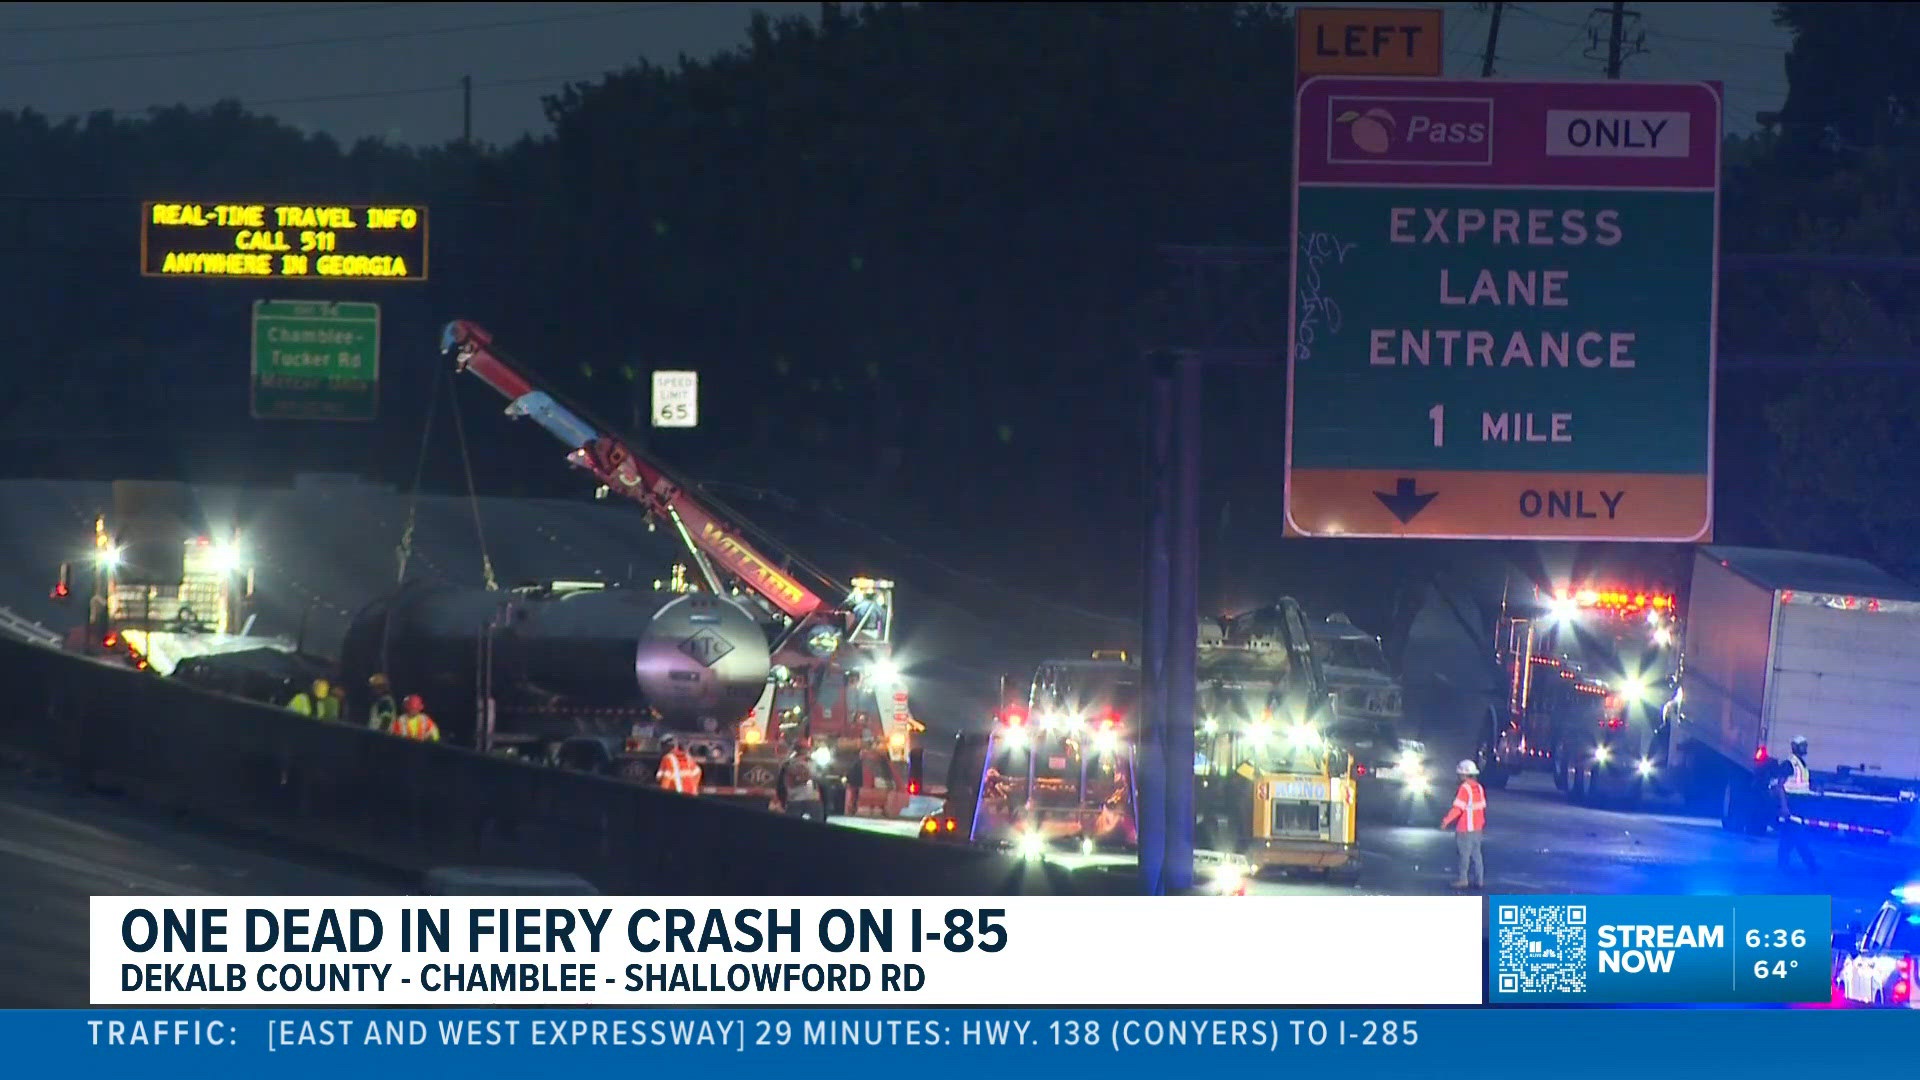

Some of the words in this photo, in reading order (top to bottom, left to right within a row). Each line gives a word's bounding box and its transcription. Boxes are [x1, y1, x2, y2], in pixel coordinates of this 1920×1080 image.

[1316, 25, 1423, 57] LEFT
[1406, 115, 1485, 144] Pass
[1567, 118, 1668, 149] ONLY
[153, 204, 265, 226] REAL-TIME
[275, 206, 357, 228] TRAVEL
[366, 208, 417, 229] INFO
[1389, 207, 1623, 246] EXPRESS
[235, 230, 291, 251] CALL
[300, 231, 335, 252] 511
[162, 252, 273, 275] ANYWHERE
[281, 255, 308, 275] IN
[316, 255, 407, 276] GEORGIA
[1440, 269, 1569, 306] LANE
[271, 350, 331, 368] Tucker
[337, 351, 361, 368] Rd
[1370, 329, 1636, 368] ENTRANCE
[657, 378, 692, 387] SPEED
[661, 391, 688, 400] LIMIT
[661, 404, 688, 420] 65
[1429, 404, 1444, 447] 1
[1482, 411, 1572, 442] MILE
[1519, 489, 1624, 520] ONLY
